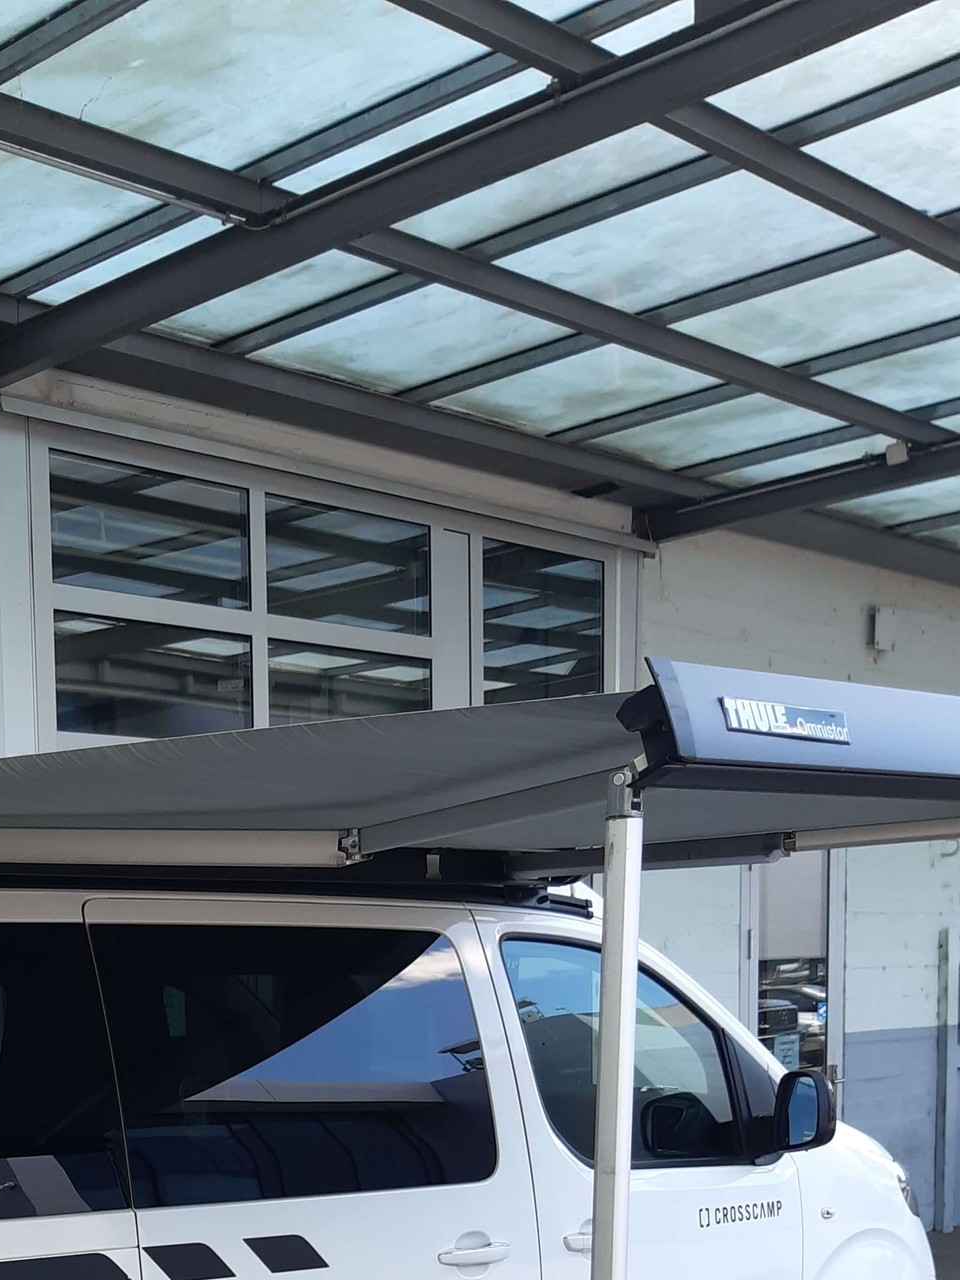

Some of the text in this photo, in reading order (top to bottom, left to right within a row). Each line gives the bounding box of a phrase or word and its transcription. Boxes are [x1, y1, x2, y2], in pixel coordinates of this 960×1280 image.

[724, 698, 849, 741] THULE Omnistor
[714, 1200, 782, 1225] CROSSCAMP
